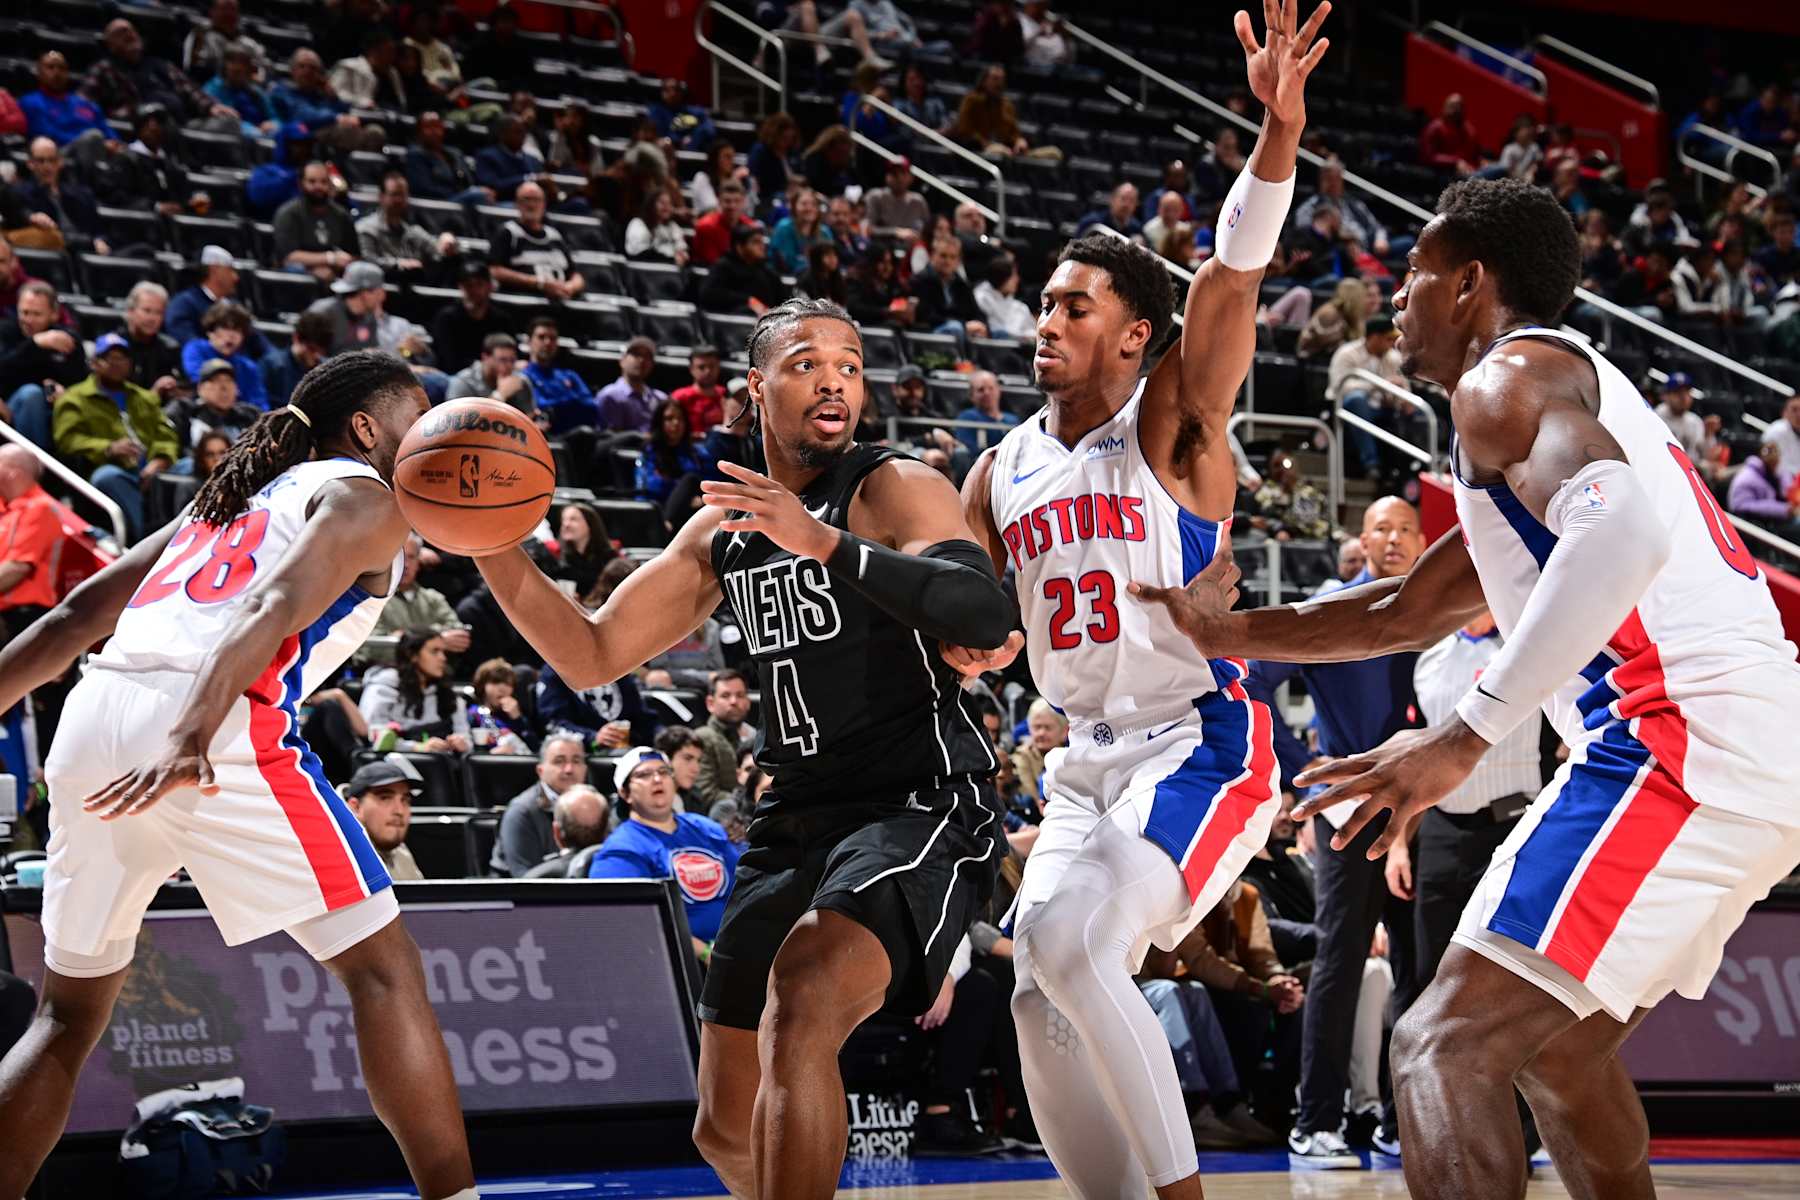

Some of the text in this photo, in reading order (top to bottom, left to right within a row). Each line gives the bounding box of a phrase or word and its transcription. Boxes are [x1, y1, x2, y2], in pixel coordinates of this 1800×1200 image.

[422, 409, 529, 445] Wilson
[126, 508, 271, 608] 28
[1002, 493, 1146, 572] PISTONS
[724, 556, 842, 655] NETS
[1043, 569, 1120, 650] 23
[772, 658, 820, 756] 4
[111, 1017, 209, 1051] planet
[128, 1043, 234, 1069] fitness
